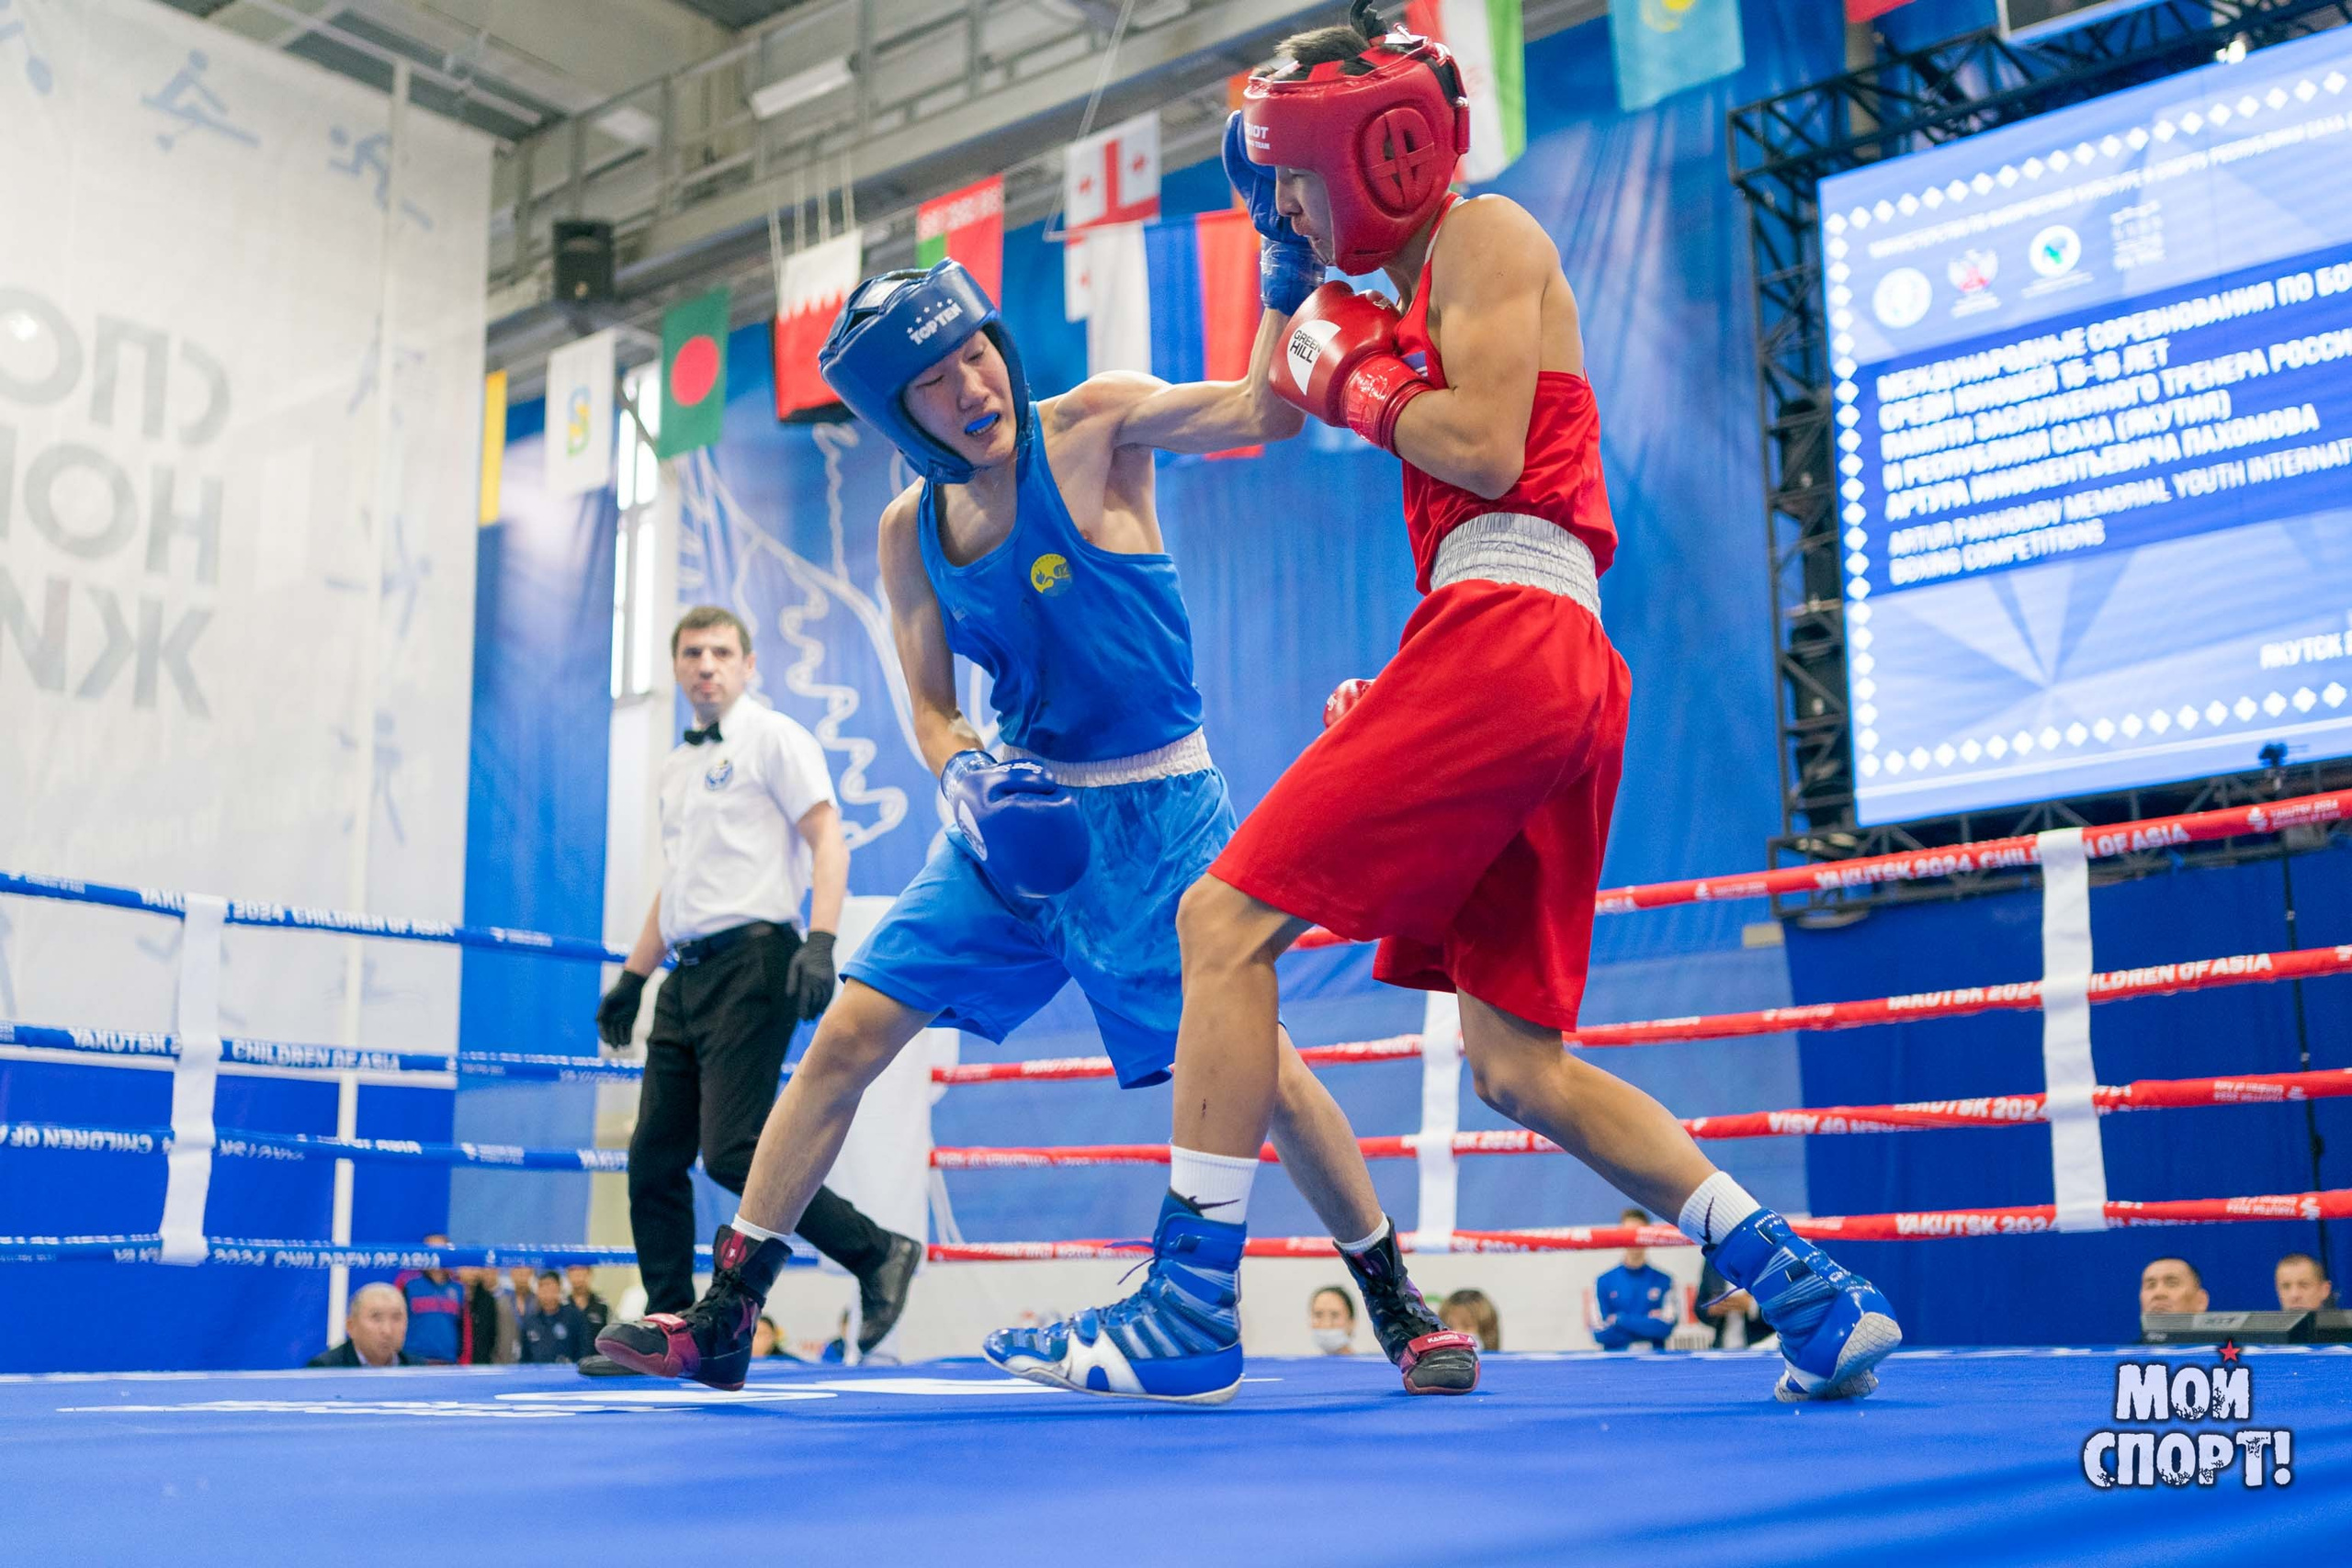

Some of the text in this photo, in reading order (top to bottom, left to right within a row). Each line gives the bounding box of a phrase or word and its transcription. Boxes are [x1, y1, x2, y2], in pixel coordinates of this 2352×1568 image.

[2276, 273, 2314, 306] ПО
[2315, 261, 2352, 297] БО
[1290, 340, 1312, 364] HILL
[1294, 330, 1322, 353] GREEN
[2121, 337, 2171, 376] ЛЕТ
[2159, 348, 2269, 397] ТРЕНЕРА
[2050, 415, 2115, 455] САХА
[2114, 389, 2232, 442] (ЯКУТИЯ)
[2180, 402, 2321, 458] ПАХОМОВА
[2171, 459, 2246, 499] YOUTH
[1815, 860, 1913, 890] YAKUTSK
[1913, 853, 1974, 879] 2024
[2098, 832, 2128, 856] OF
[2132, 823, 2190, 851] ASIA
[232, 899, 287, 922] 2024
[290, 906, 386, 932] CHILDREN
[2177, 959, 2211, 981] OF
[2211, 953, 2273, 976] ASIA
[67, 1027, 165, 1053] YAKUTSK
[232, 1038, 330, 1068] CHILDREN
[332, 1048, 357, 1069] OF
[357, 1052, 401, 1072] ASIA
[42, 1126, 154, 1154] CHILDREN
[1895, 1213, 1998, 1235] YAKUTSK
